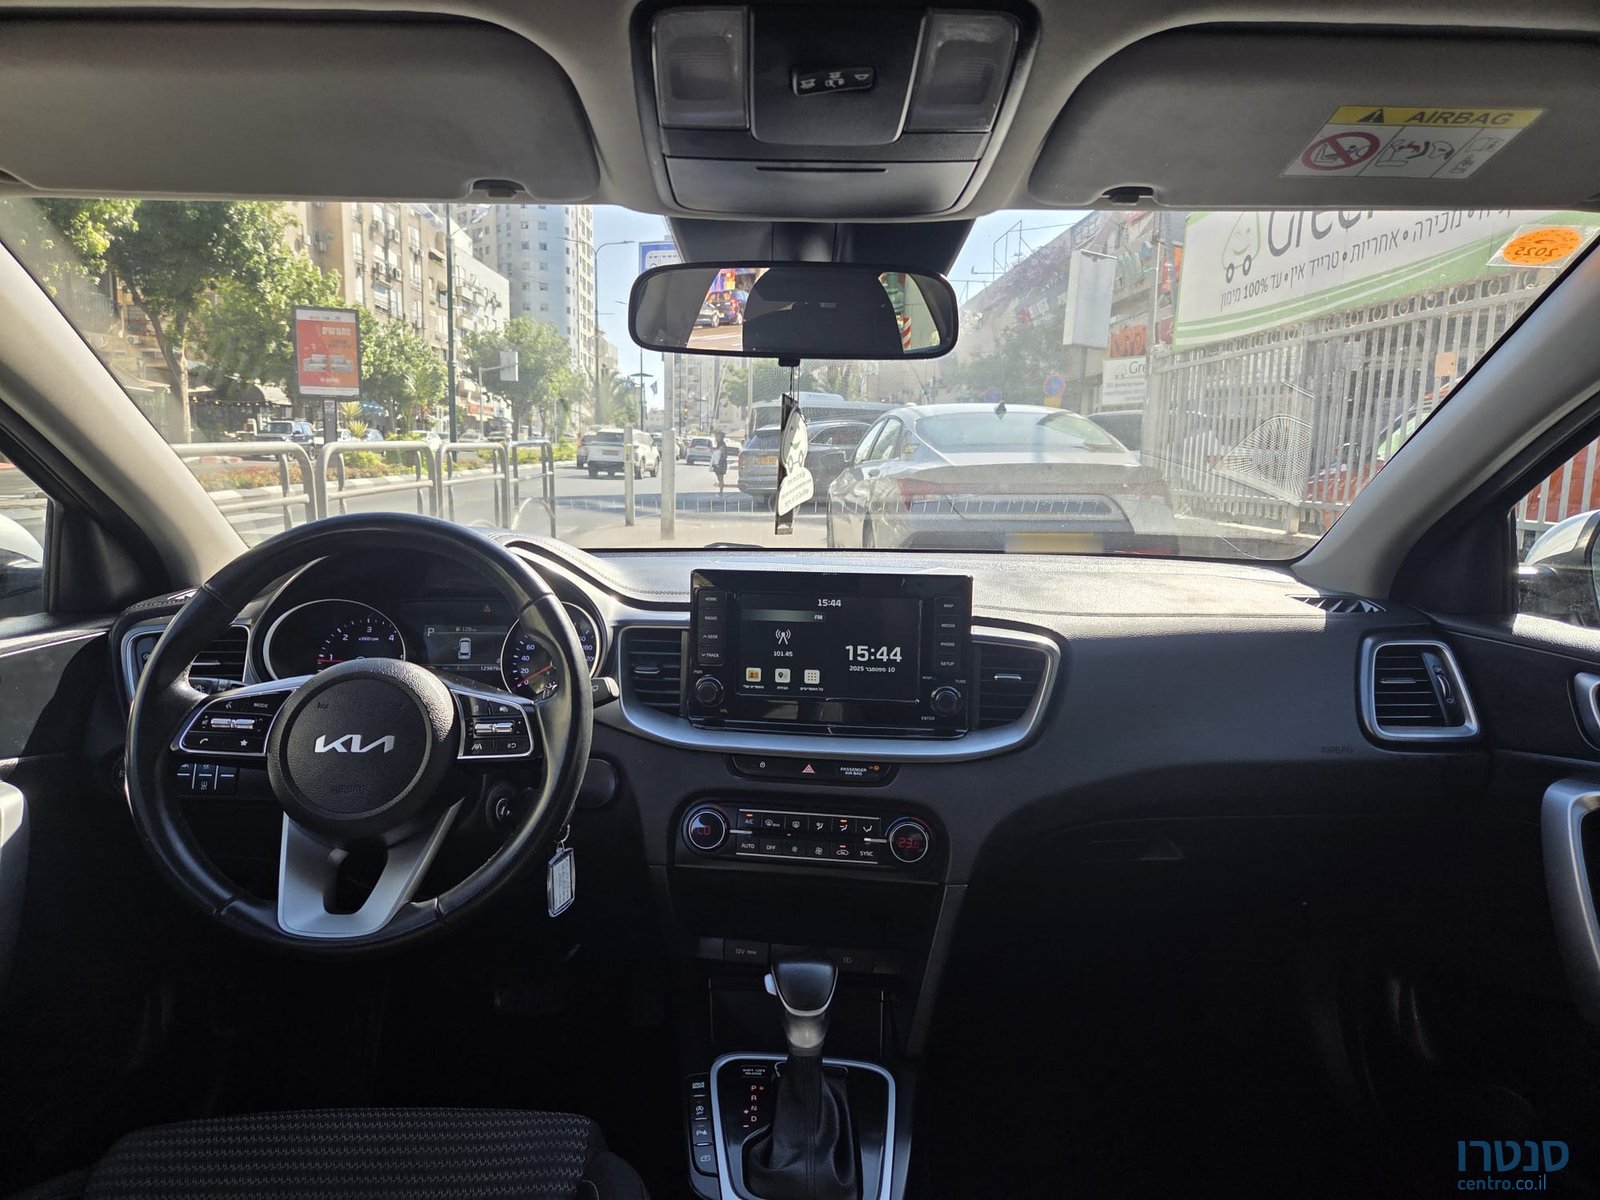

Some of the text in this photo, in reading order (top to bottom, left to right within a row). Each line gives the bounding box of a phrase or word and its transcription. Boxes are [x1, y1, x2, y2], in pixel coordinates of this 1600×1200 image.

[1404, 111, 1515, 125] AIRBAG
[1350, 228, 1401, 263] אחריות
[1309, 250, 1340, 276] טרייד
[1271, 273, 1283, 289] עד
[1290, 263, 1307, 288] אין
[1243, 277, 1269, 300] 100%
[1219, 287, 1241, 312] מימון
[817, 599, 842, 607] 15:44
[342, 633, 349, 641] 2
[427, 627, 435, 637] P
[845, 645, 902, 662] 15:44
[314, 734, 395, 753] KIA
